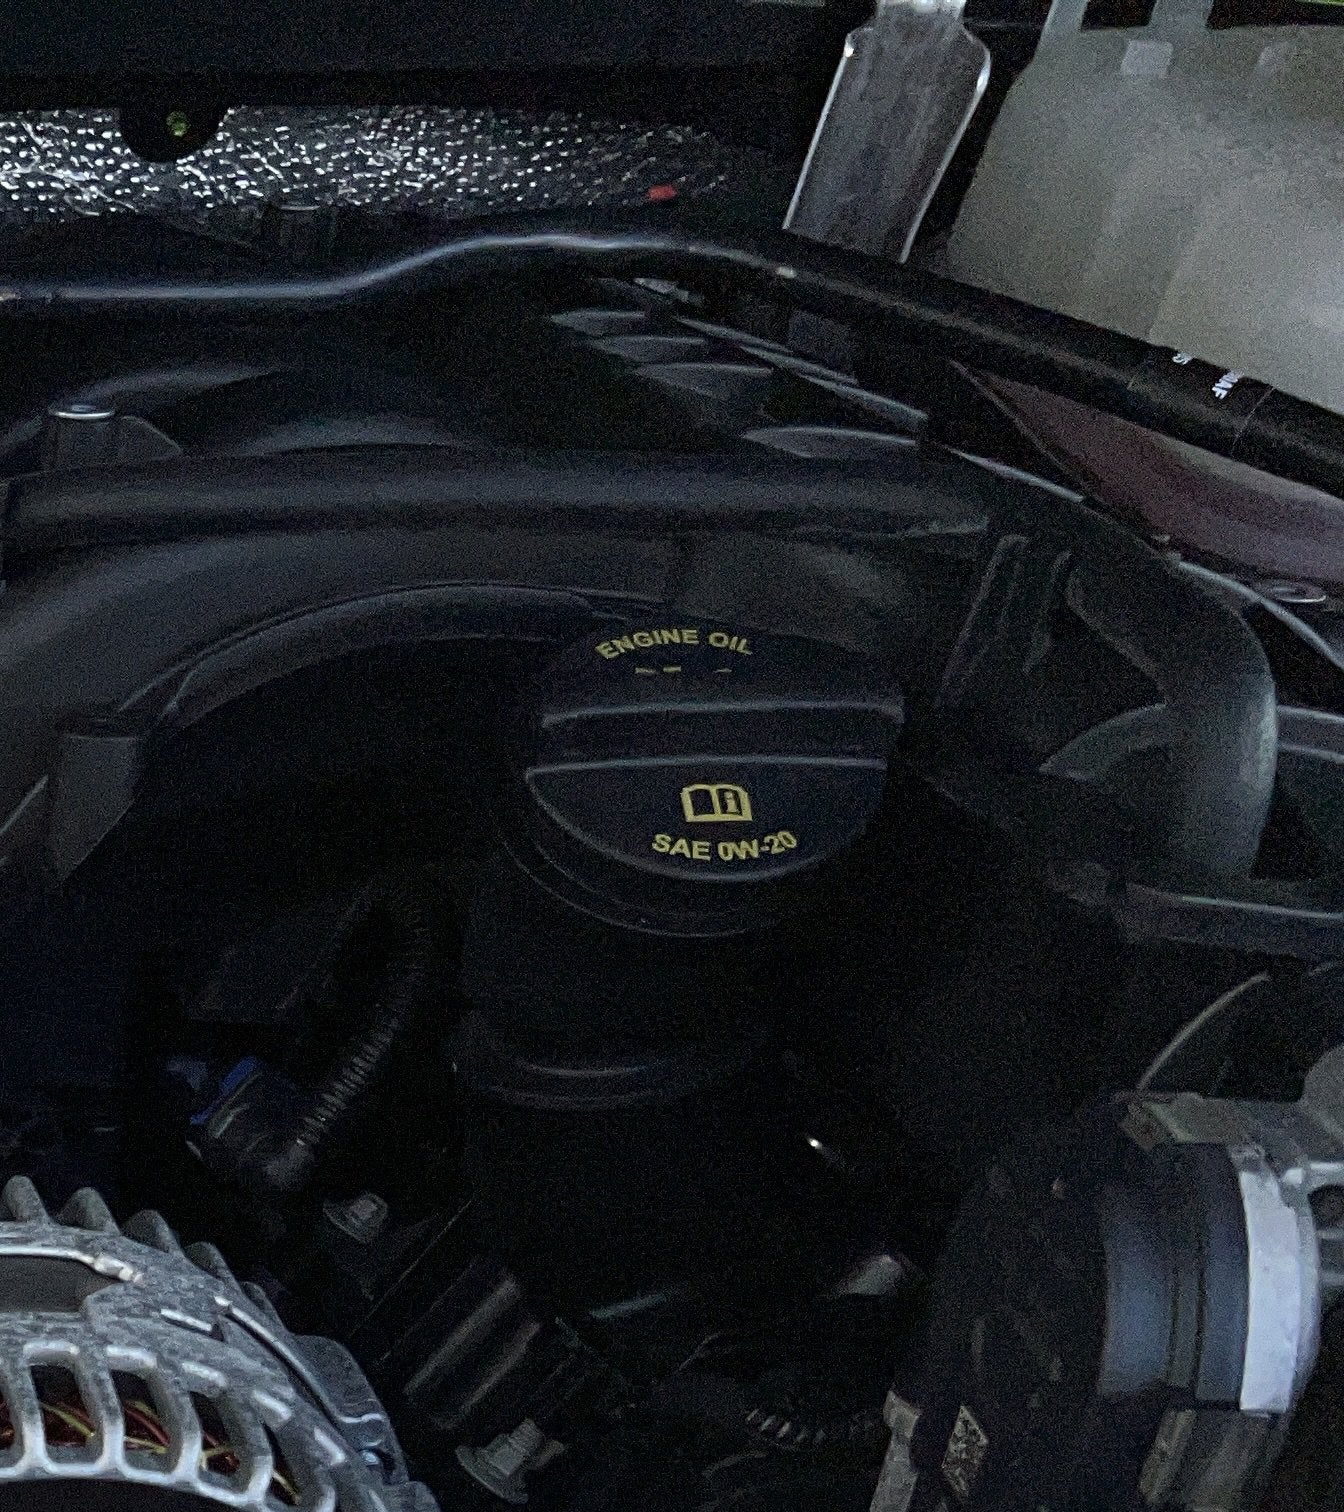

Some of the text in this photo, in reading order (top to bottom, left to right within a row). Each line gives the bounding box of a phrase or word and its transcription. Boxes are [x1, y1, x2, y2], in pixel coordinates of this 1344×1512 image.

[595, 629, 753, 660] ENGINE OIL
[652, 830, 798, 861] SAE 0W-20
